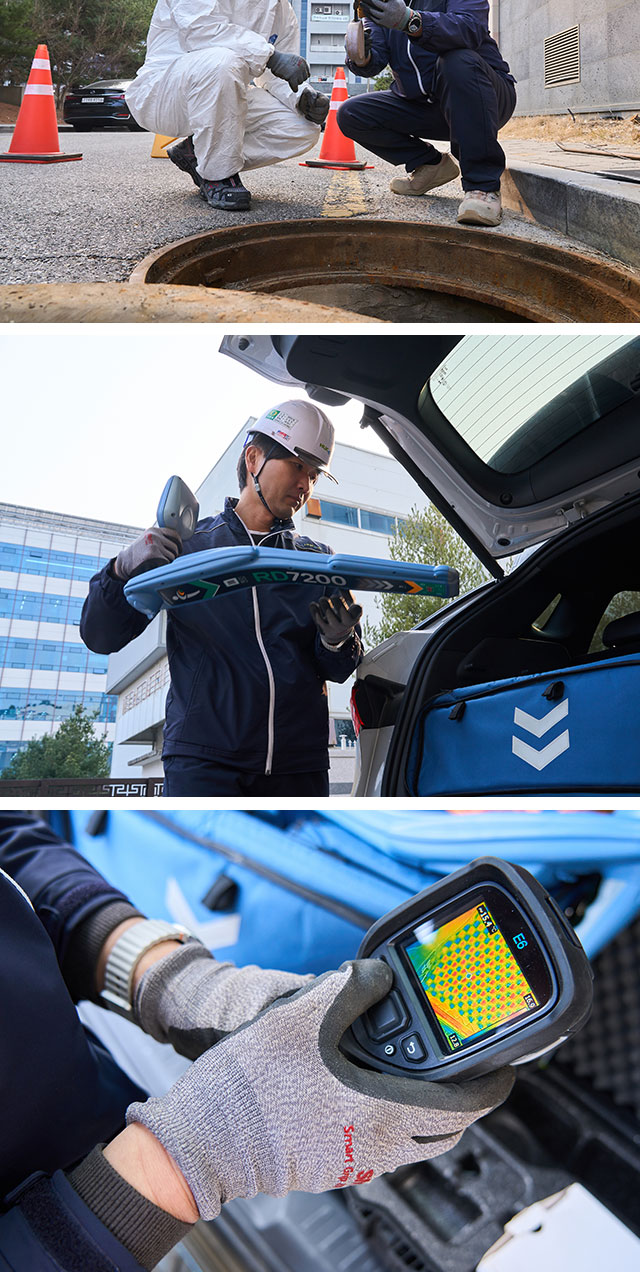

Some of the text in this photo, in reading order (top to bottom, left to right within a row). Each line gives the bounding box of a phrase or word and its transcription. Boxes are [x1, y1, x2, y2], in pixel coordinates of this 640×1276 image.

[252, 570, 347, 587] RD7200
[512, 932, 528, 950] E6
[524, 994, 536, 1009] 16.9
[450, 1034, 460, 1048] 12.8
[344, 1125, 354, 1163] Smart
